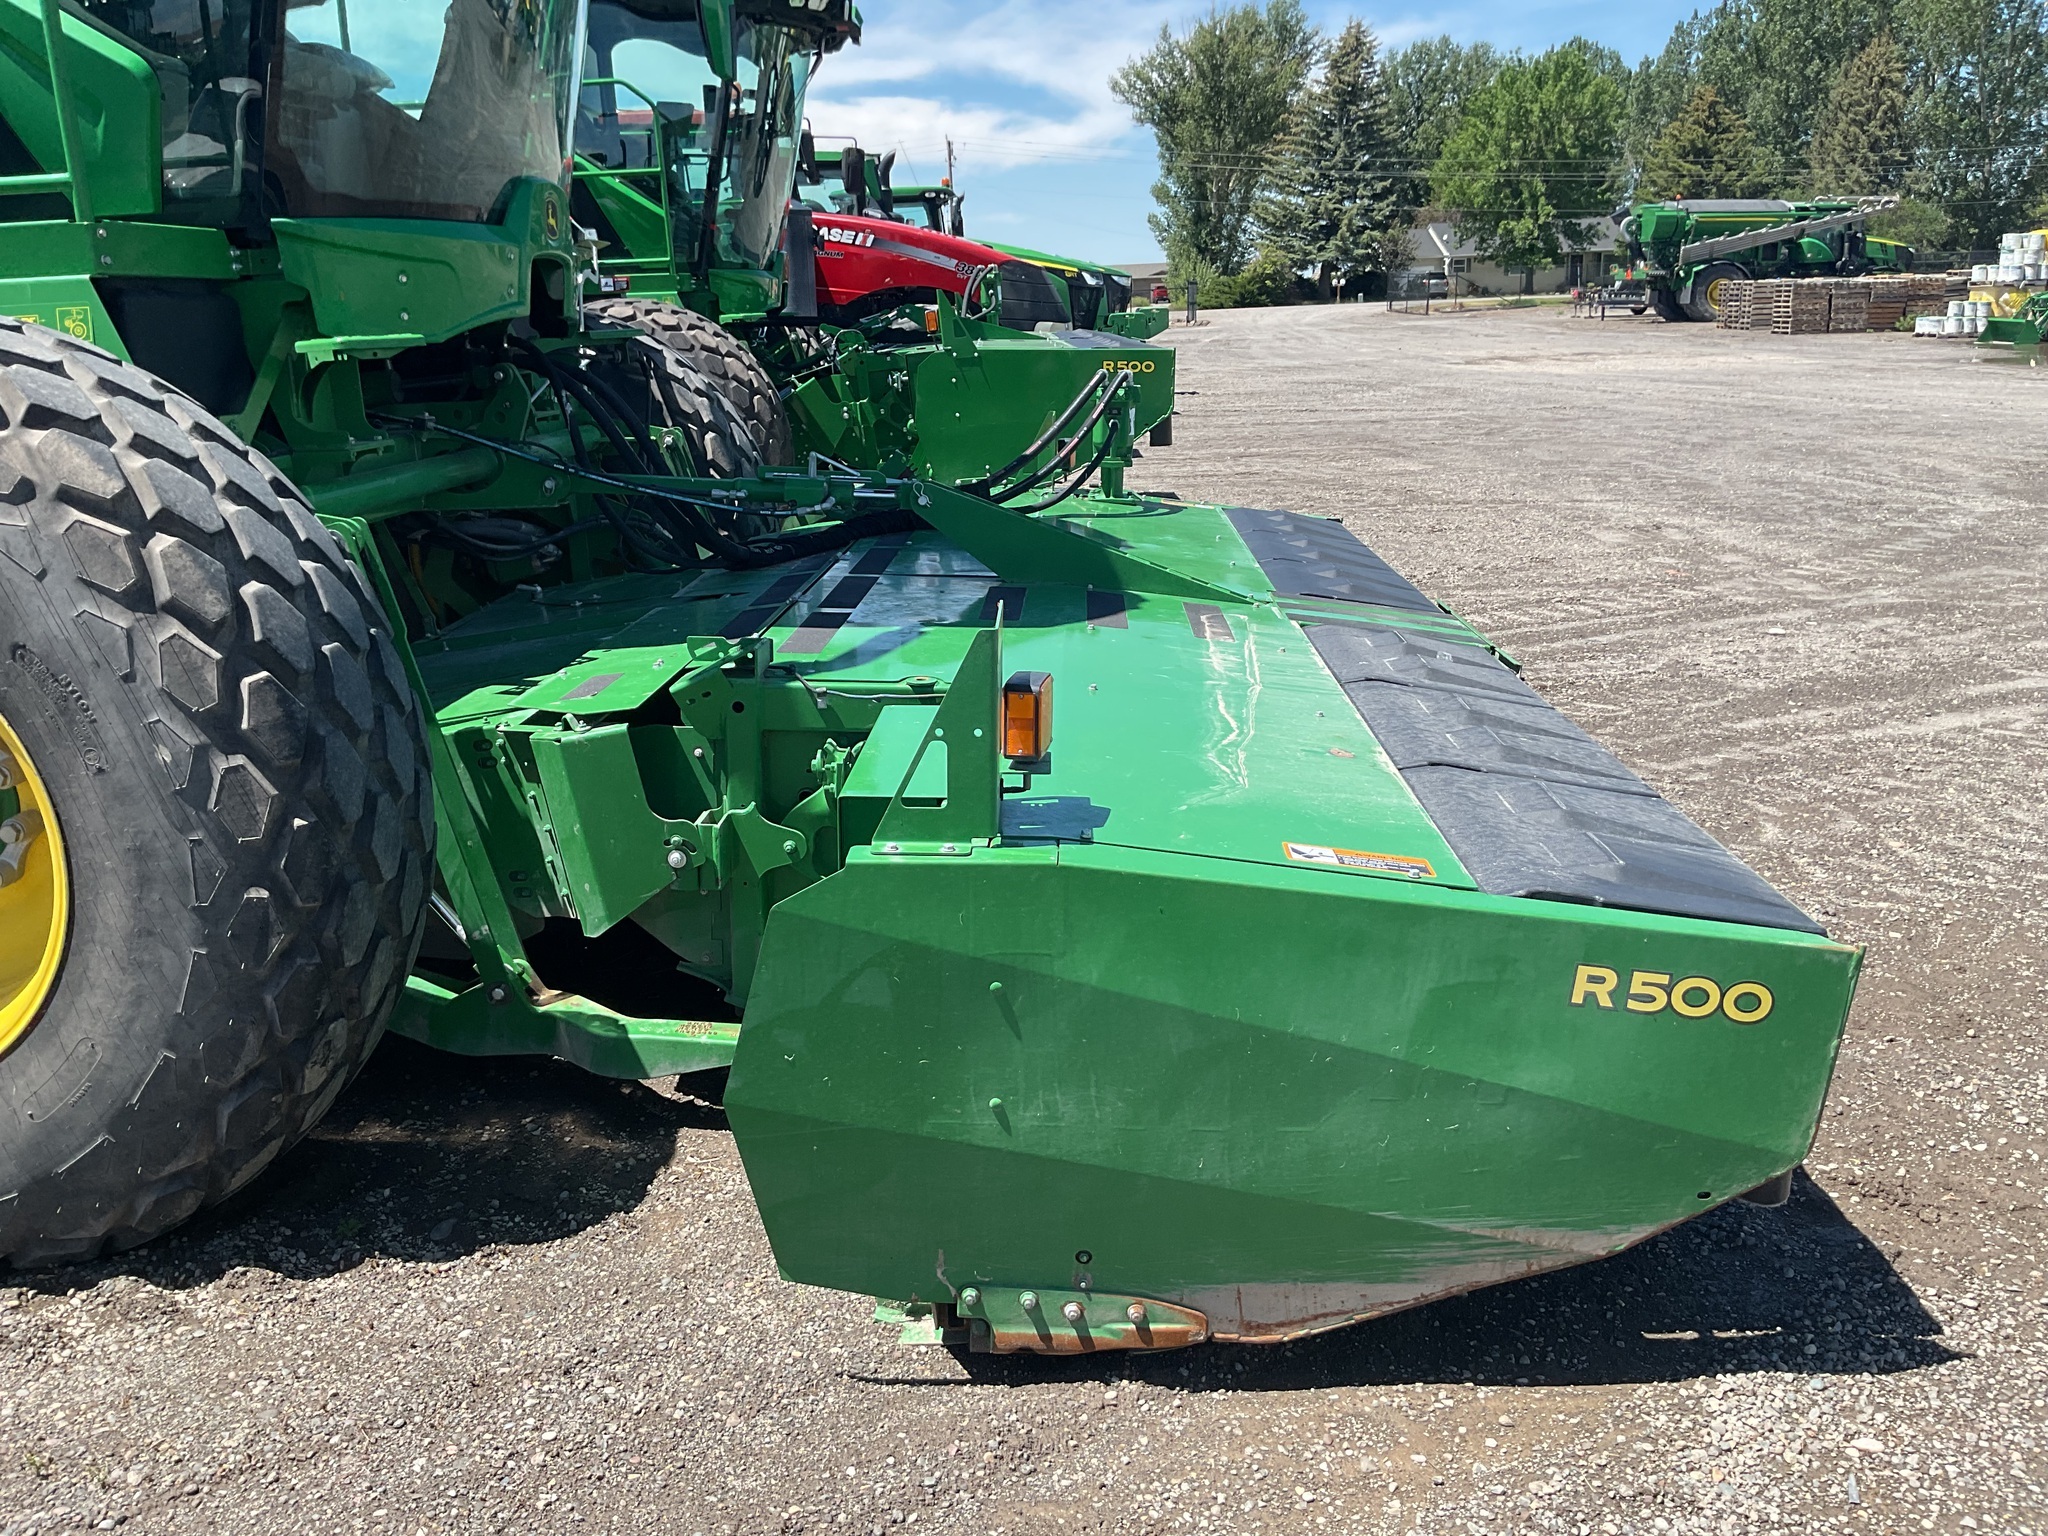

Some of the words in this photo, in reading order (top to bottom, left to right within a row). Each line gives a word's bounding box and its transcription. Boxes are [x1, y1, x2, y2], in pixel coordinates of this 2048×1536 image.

[812, 225, 856, 244] ASE
[815, 250, 845, 259] GNUM
[955, 261, 977, 277] 38
